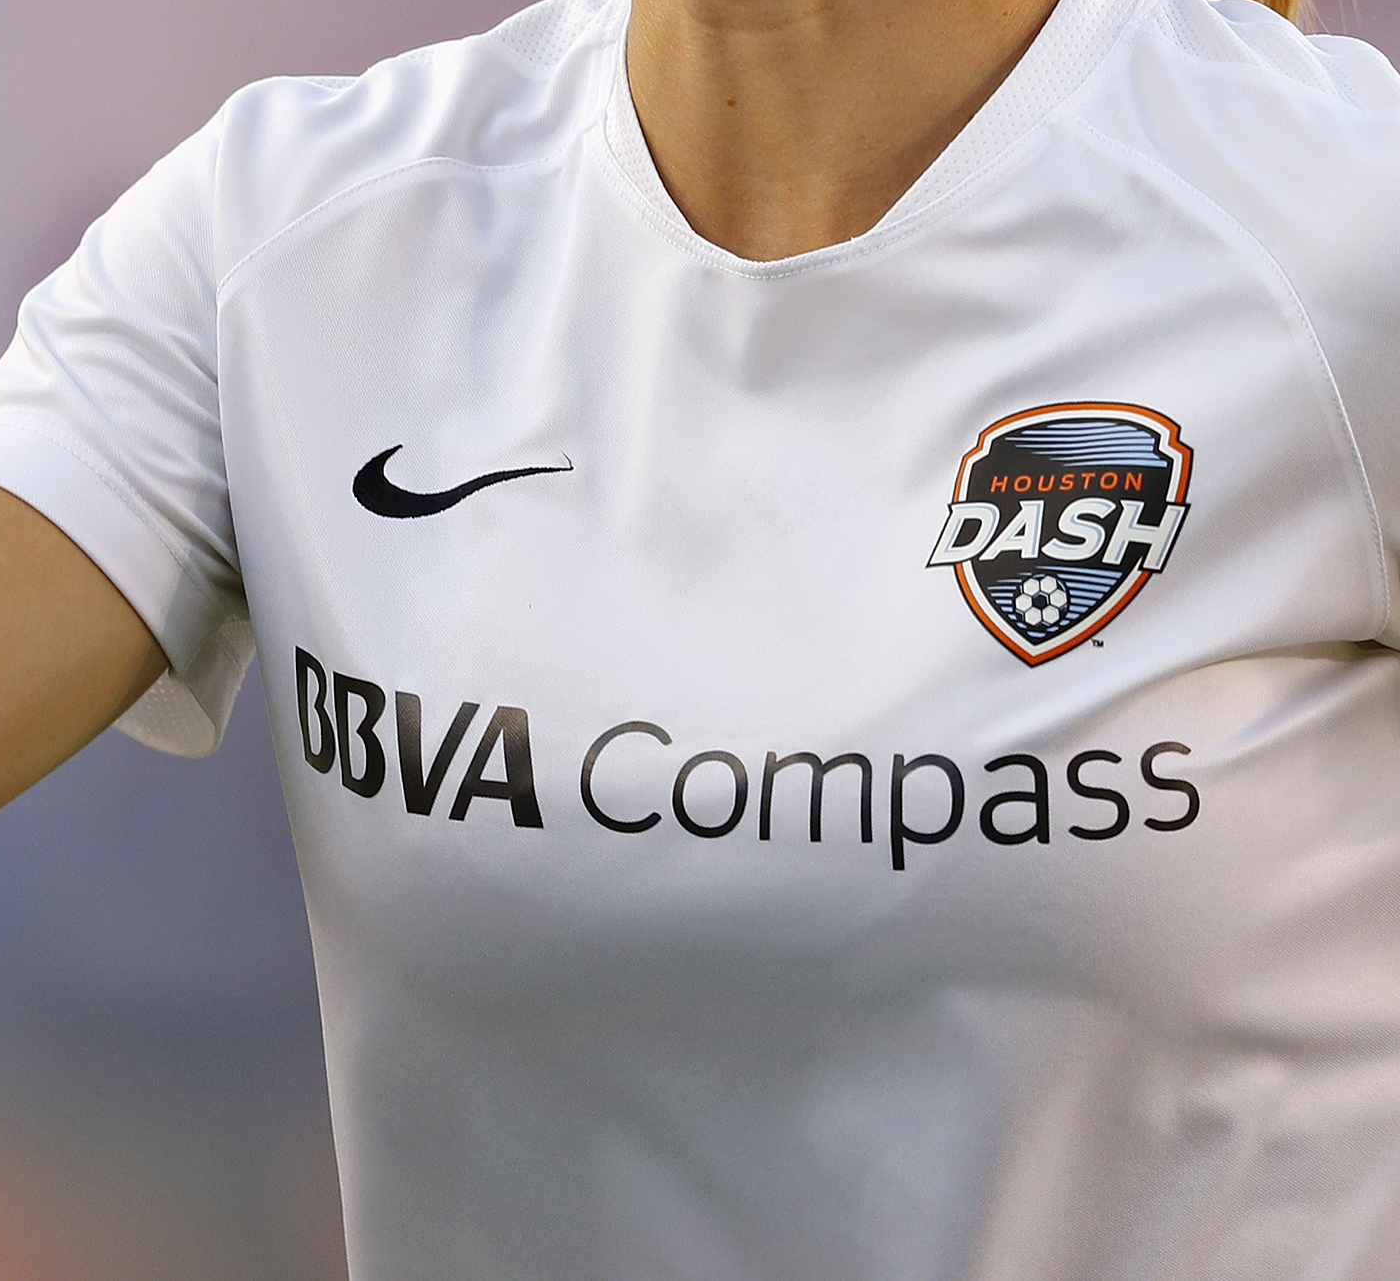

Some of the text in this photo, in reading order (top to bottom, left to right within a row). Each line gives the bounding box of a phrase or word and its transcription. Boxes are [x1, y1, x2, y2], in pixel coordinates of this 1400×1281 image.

[990, 472, 1144, 493] HOUSTON
[927, 497, 1189, 572] DASH
[295, 647, 1201, 871] BBVA Compass
